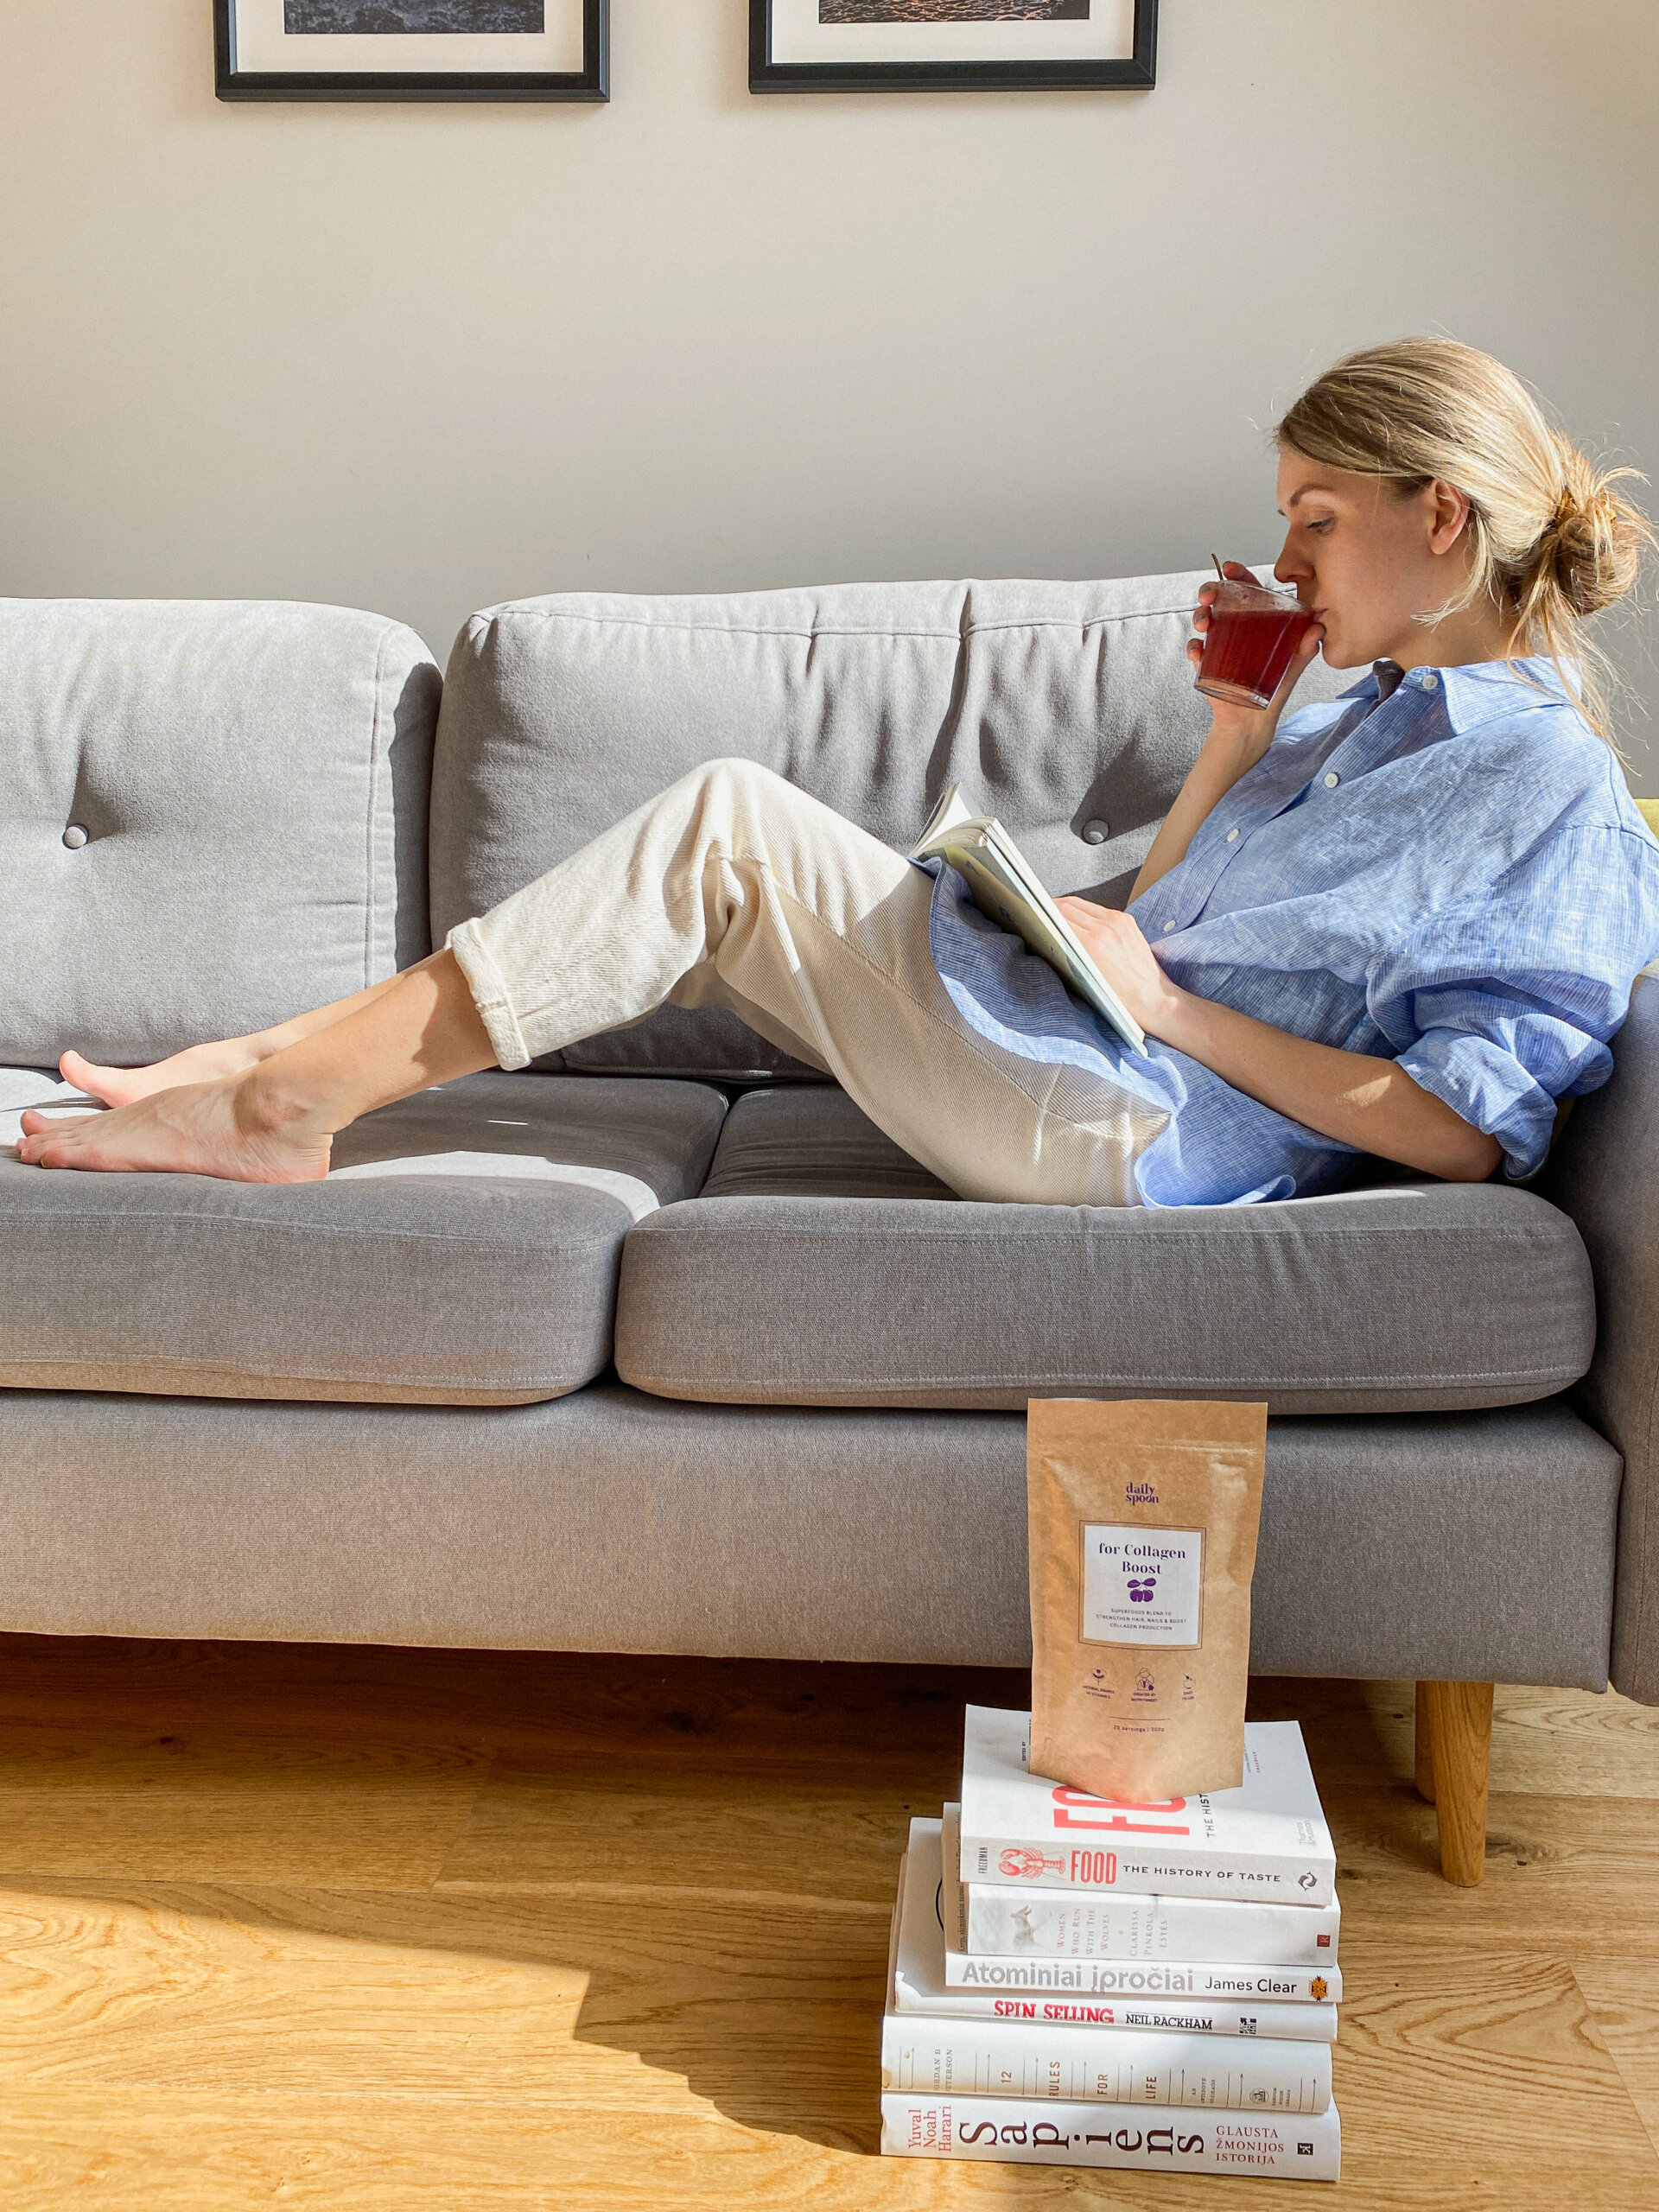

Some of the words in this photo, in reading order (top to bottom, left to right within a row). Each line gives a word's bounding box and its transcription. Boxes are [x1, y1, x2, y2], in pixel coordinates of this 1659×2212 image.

[1126, 1482, 1154, 1496] daily
[1126, 1494, 1159, 1505] spoon
[1099, 1542, 1120, 1554] for
[1124, 1544, 1186, 1560] Collagen
[1122, 1560, 1162, 1574] Boost
[1199, 1793, 1211, 1815] HIST
[1205, 1819, 1216, 1838] THE
[978, 1847, 988, 1874] FREEDMAN
[1071, 1850, 1117, 1885] FOOD
[1123, 1865, 1148, 1873] THE
[1154, 1866, 1211, 1878] HISTORY
[1239, 1873, 1281, 1882] TASTE
[1087, 1909, 1096, 1925] THE
[1057, 1913, 1066, 1948] WOMEN
[1101, 1914, 1110, 1949] WOLVES
[1129, 1910, 1139, 1956] CLARISSA
[1144, 1912, 1154, 1955] PINKOLA
[1071, 1932, 1080, 1954] WHO
[963, 1961, 1082, 1987] Atominiai
[1091, 1965, 1193, 1993] įpročiai
[1205, 1976, 1253, 1991] James
[1257, 1979, 1297, 1993] Clear
[995, 1999, 1037, 2018] SPIN
[1043, 2004, 1115, 2024] SELLING
[1126, 2013, 1152, 2025] NEIL
[1153, 2016, 1212, 2031] RACKHAM
[1001, 2071, 1012, 2083] 12
[1049, 2061, 1060, 2096] RULES
[1097, 2074, 1108, 2095] FOR
[1145, 2076, 1157, 2099] LIFE
[908, 2109, 921, 2149] Yuval
[924, 2110, 937, 2149] Noah
[938, 2105, 951, 2152] Harari
[1216, 2125, 1279, 2139] GLAUSTA
[1216, 2139, 1285, 2154] ŽMONIJOS
[1216, 2152, 1275, 2165] ISTORIJA
